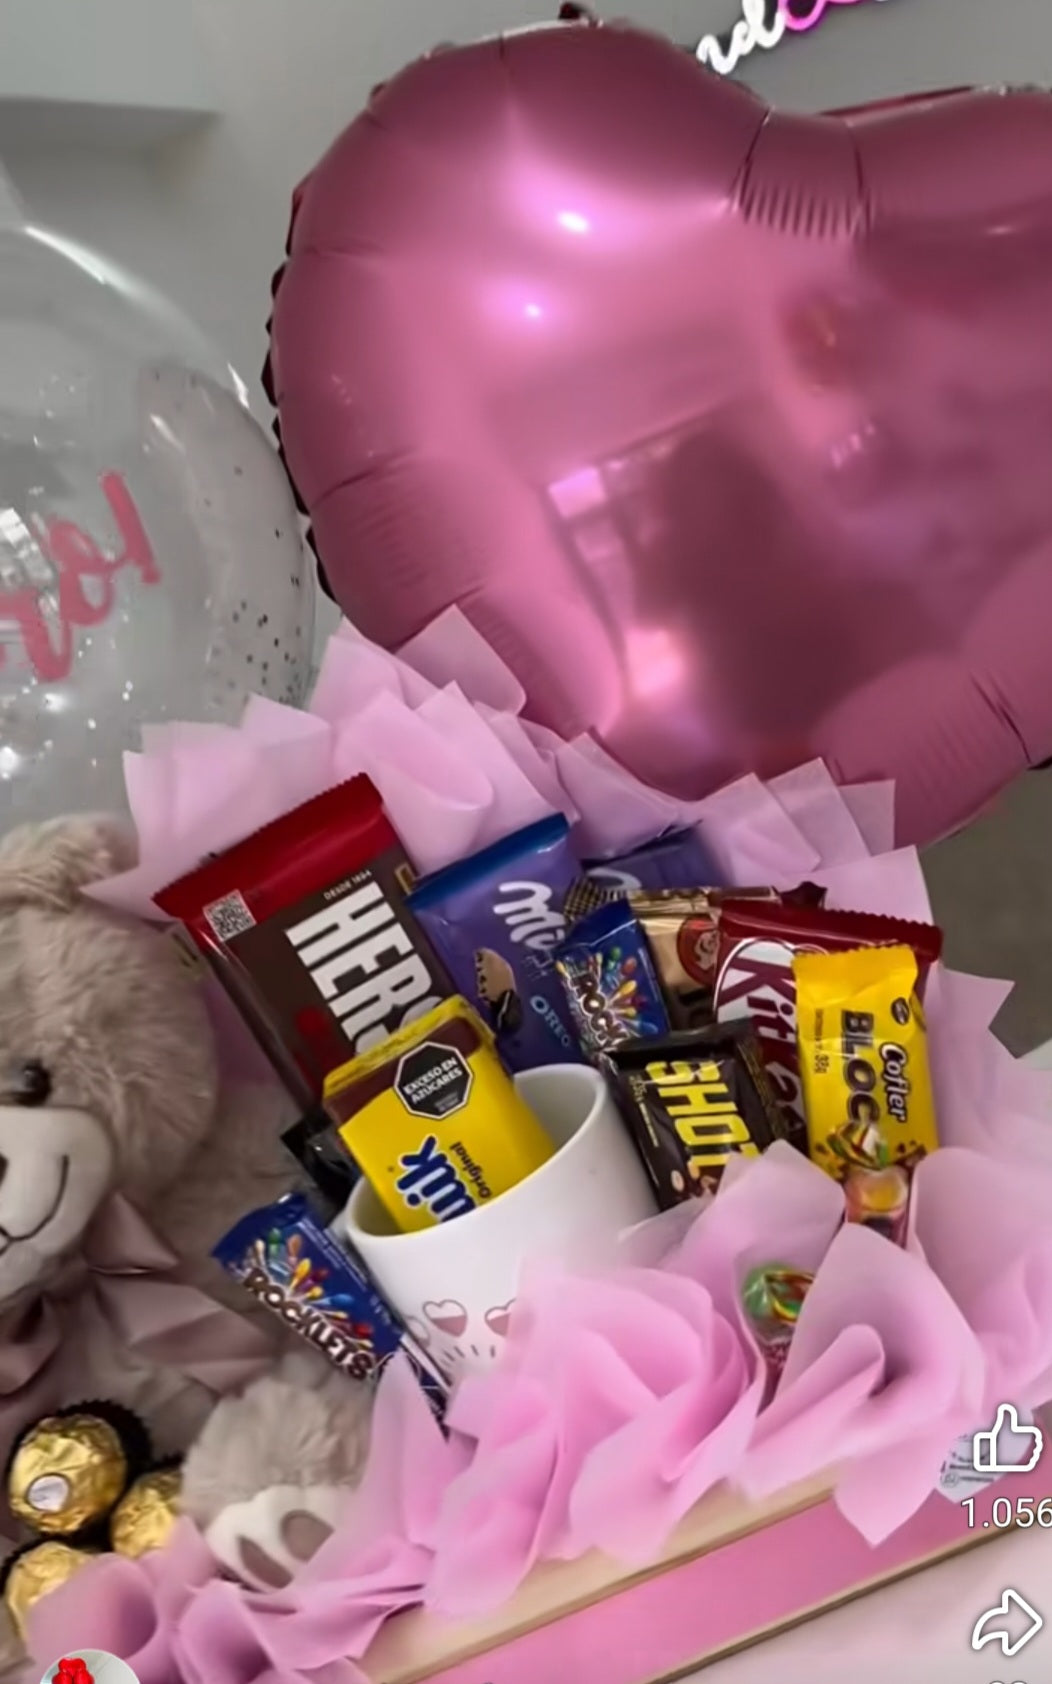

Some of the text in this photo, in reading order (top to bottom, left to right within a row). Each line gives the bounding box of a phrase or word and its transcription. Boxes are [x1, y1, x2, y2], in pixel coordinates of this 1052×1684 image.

[530, 995, 572, 1048] OREO
[717, 956, 797, 1044] Kit
[403, 1056, 459, 1096] EXCESO EN
[410, 1067, 463, 1105] AZUCARES
[880, 1043, 911, 1124] Cofler
[645, 1061, 762, 1168] SHOT
[449, 1141, 493, 1199] Original
[243, 1264, 377, 1382] ROCKLETS
